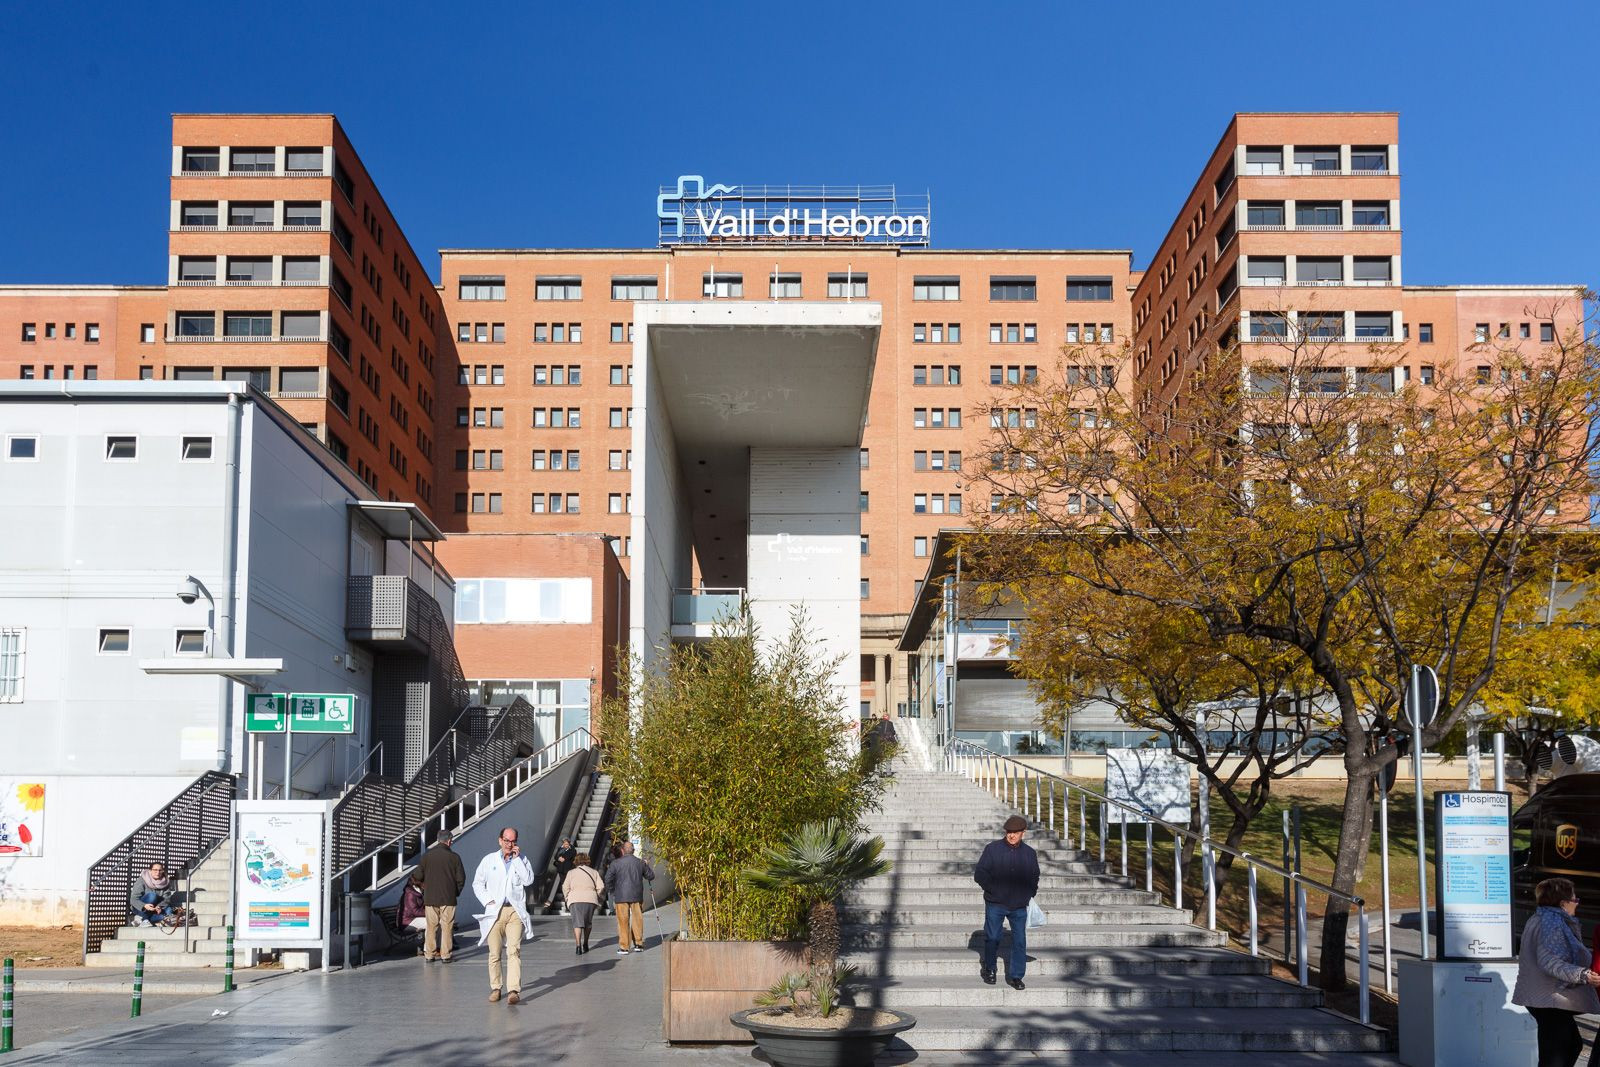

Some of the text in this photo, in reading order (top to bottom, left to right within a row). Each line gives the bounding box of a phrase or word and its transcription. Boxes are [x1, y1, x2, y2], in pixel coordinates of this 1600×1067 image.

[696, 208, 928, 237] Vall d'Hebron
[1557, 834, 1575, 853] ups
